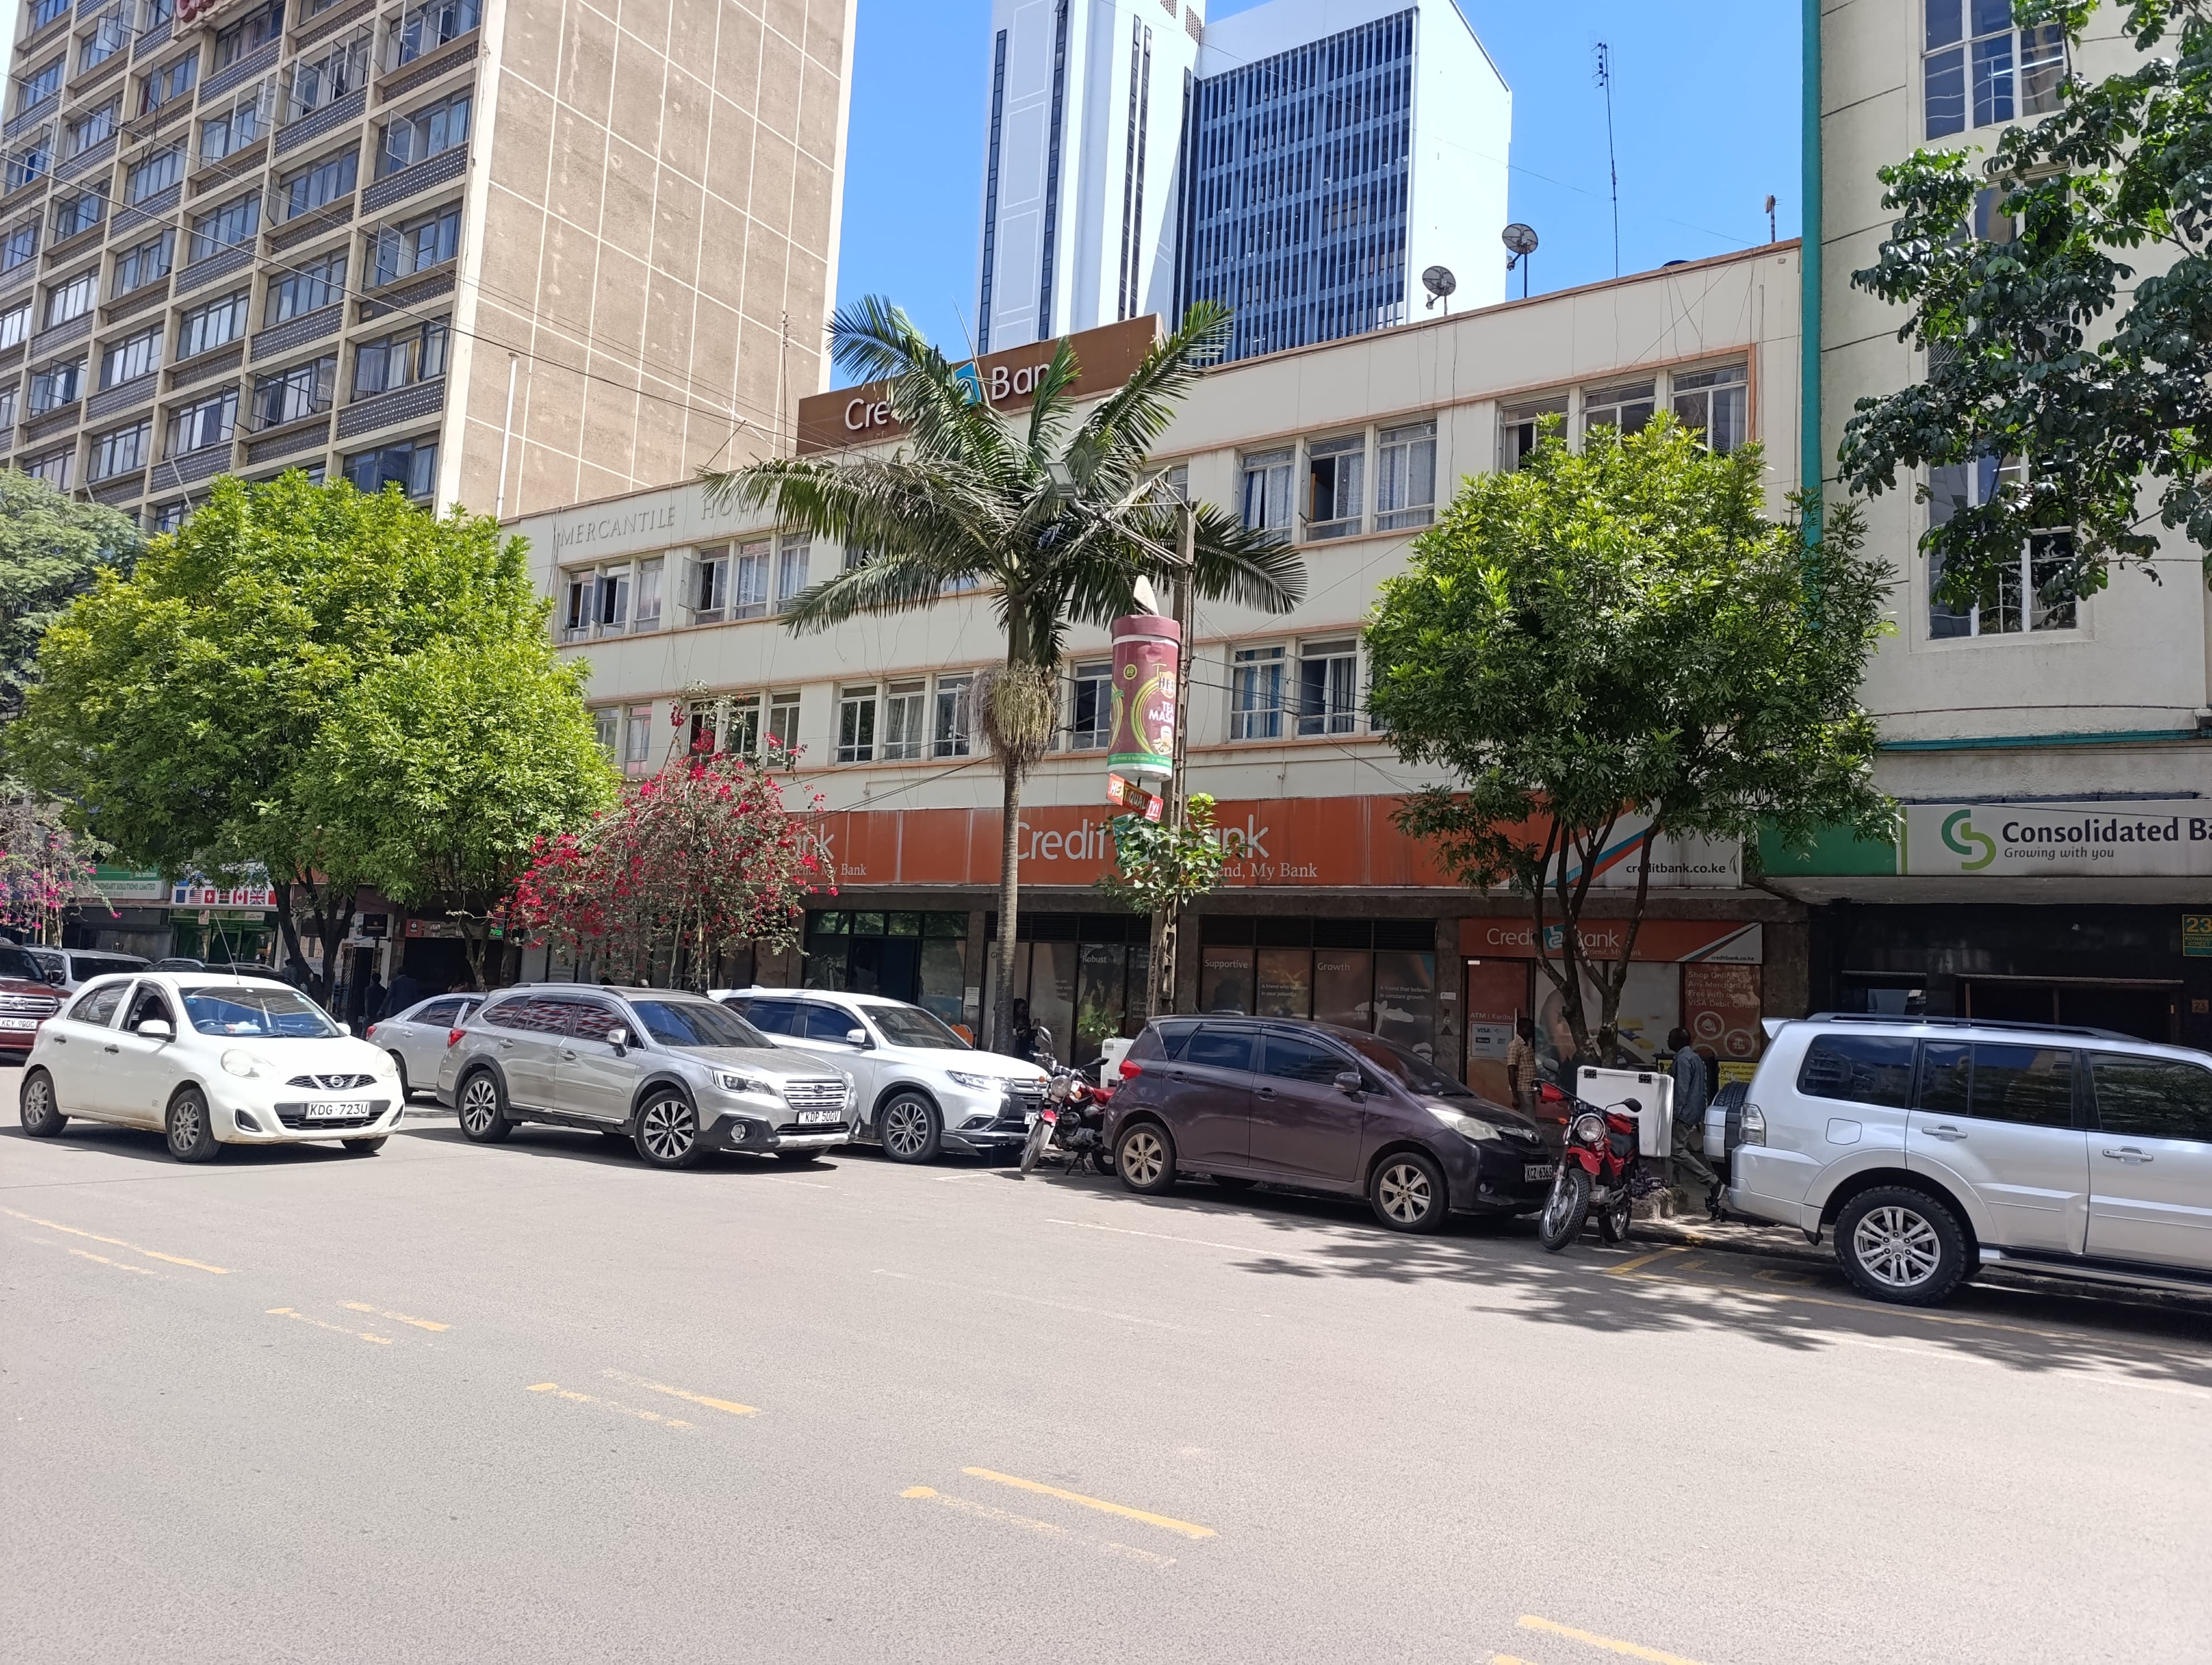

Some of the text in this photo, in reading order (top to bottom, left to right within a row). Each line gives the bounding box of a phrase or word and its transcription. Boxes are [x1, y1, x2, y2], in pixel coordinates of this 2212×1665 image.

[991, 363, 1056, 400] Ban
[559, 487, 775, 546] MERCANTILE HOE
[1149, 709, 1175, 725] MAS
[1185, 814, 1270, 858] ank
[2002, 817, 2212, 843] Consolidated B
[2004, 847, 2115, 860] Growing with you
[840, 863, 867, 875] Bank
[1250, 863, 1275, 880] My
[1279, 862, 1318, 878] Bank
[2186, 917, 2212, 933] 23
[1487, 927, 1534, 945] Credi
[1082, 955, 1107, 963] Robust
[1205, 959, 1248, 970] Supportive
[1317, 962, 1350, 972] Growth
[1688, 972, 1709, 980] Shop
[1710, 1000, 1729, 1008] Debit
[310, 1103, 368, 1116] KDG 723U
[805, 1111, 819, 1122] KDP
[1527, 1167, 1552, 1179] KCZ 636S
